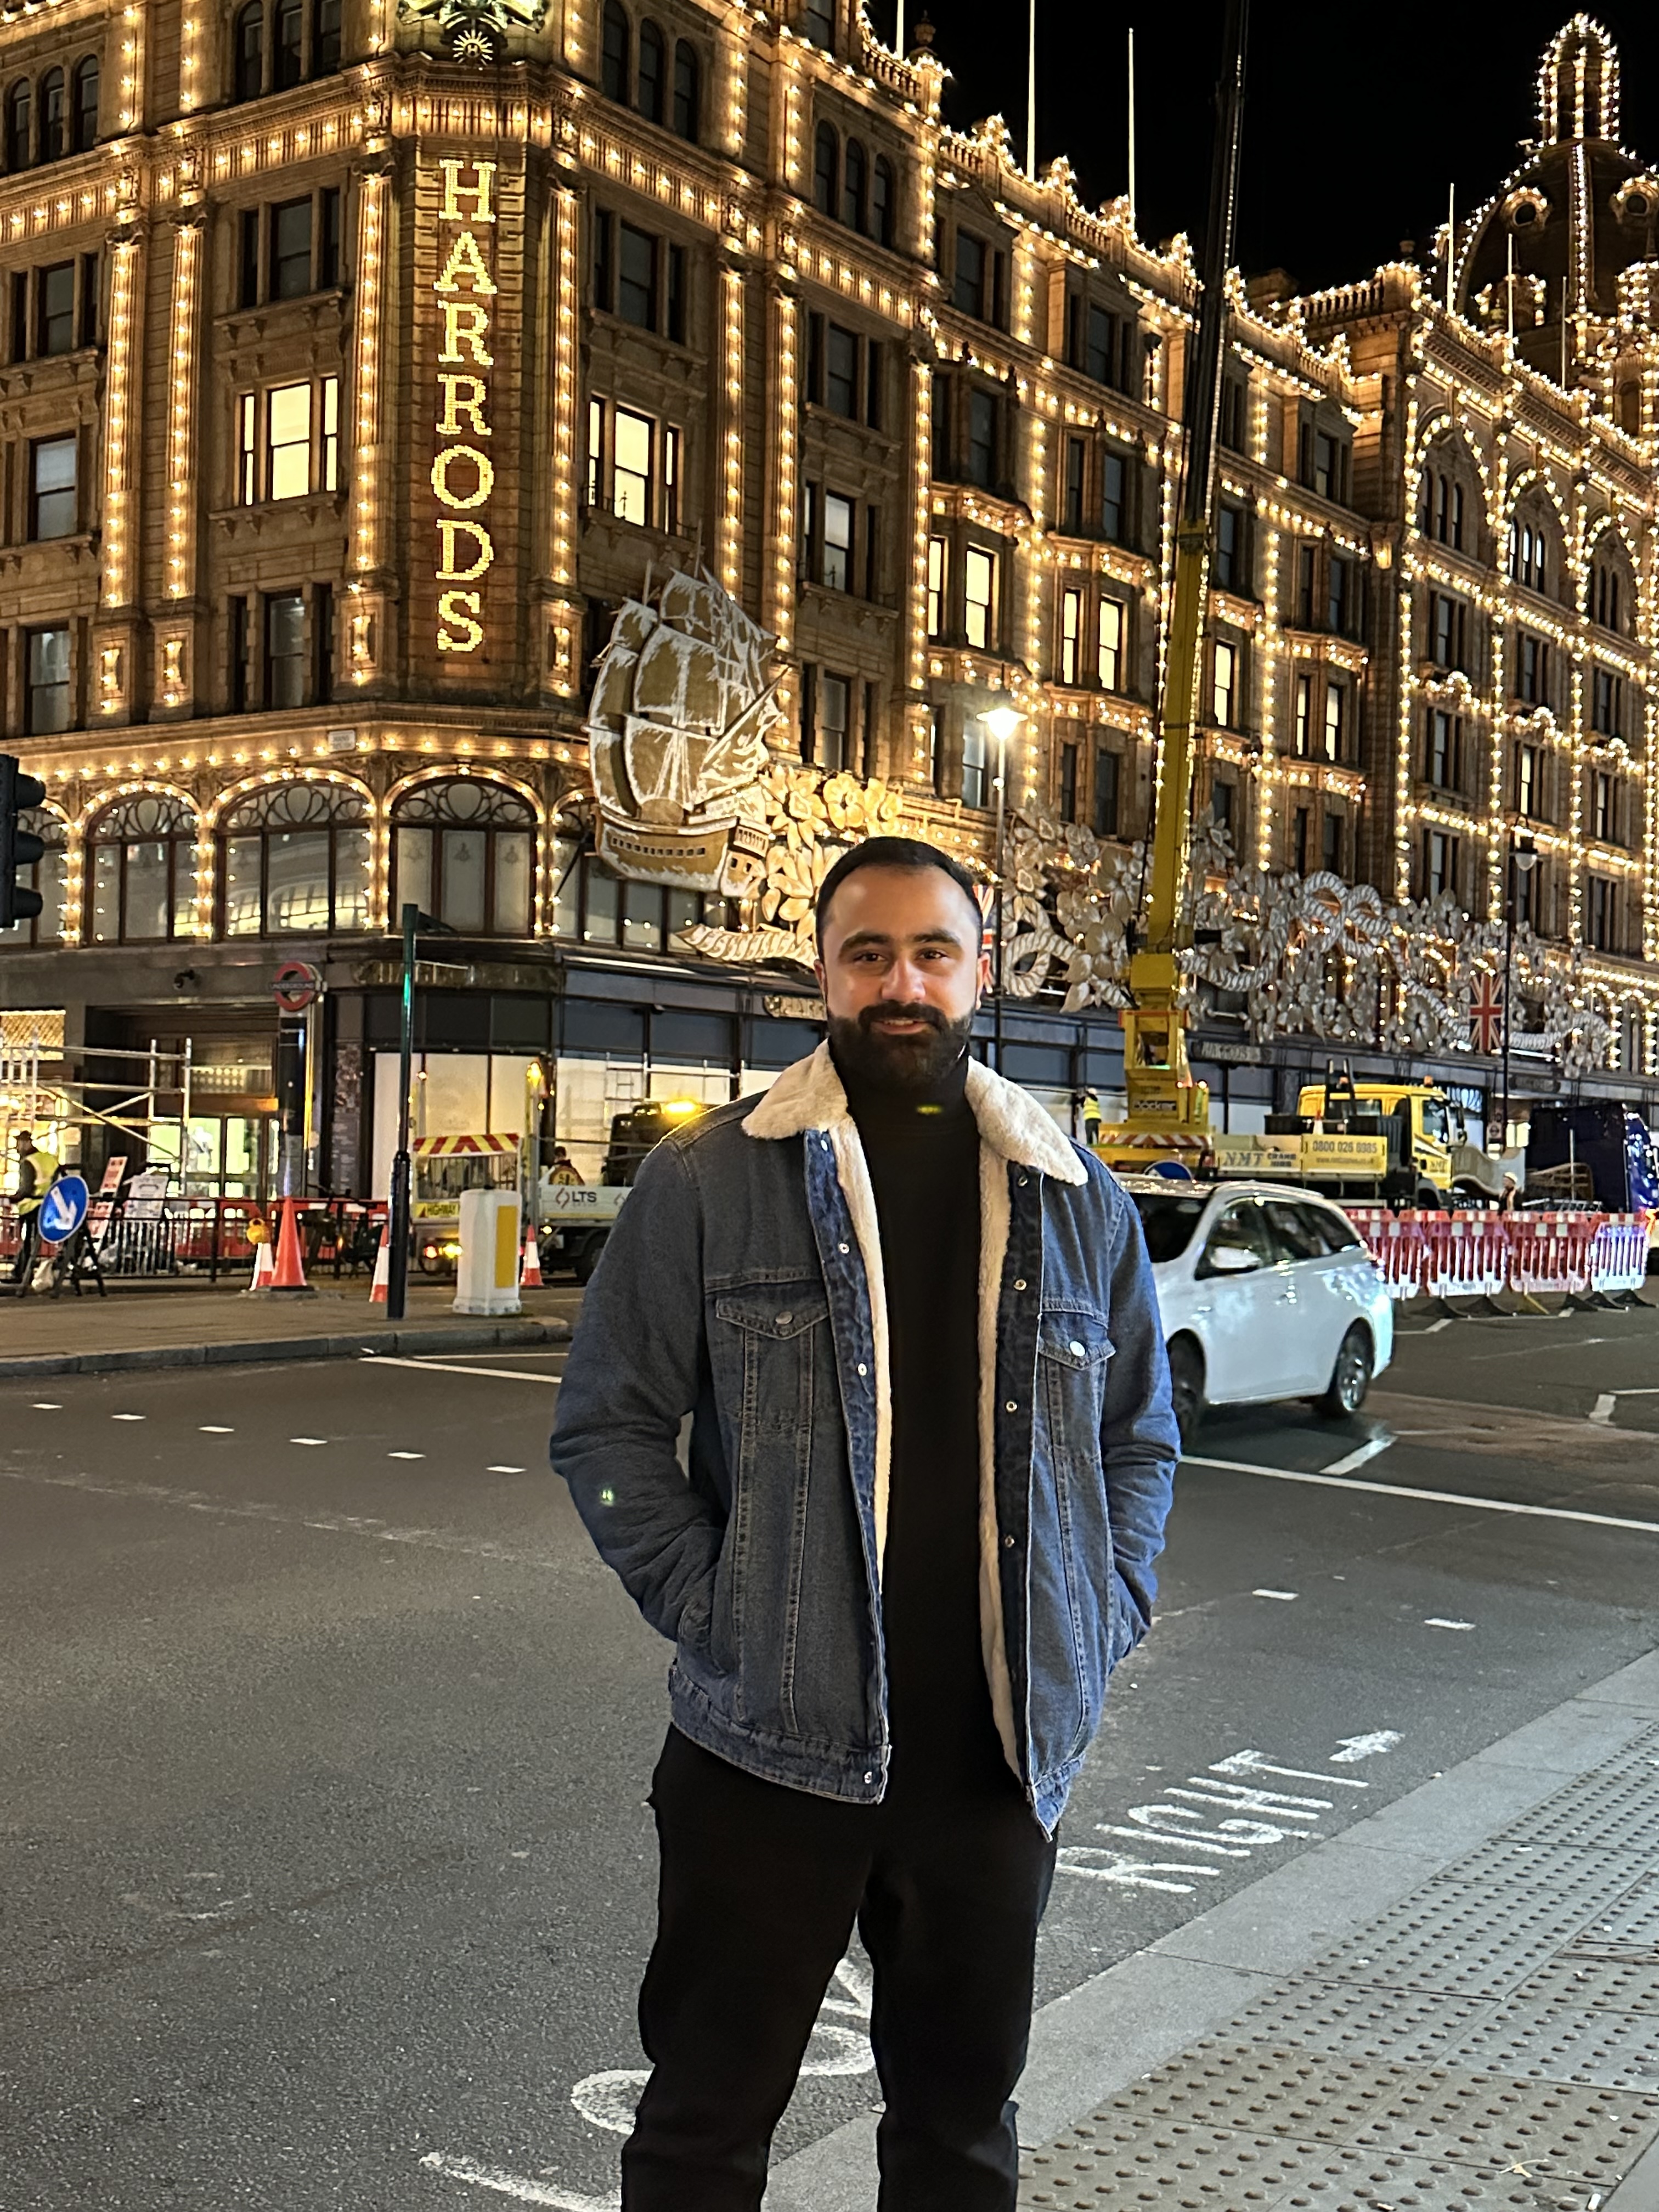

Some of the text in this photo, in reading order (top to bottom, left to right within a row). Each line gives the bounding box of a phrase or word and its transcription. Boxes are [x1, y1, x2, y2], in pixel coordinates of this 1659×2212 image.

[431, 159, 498, 652] HARRODS
[1312, 1140, 1335, 1152] 0800
[1223, 1152, 1263, 1167] NMT
[572, 1190, 597, 1203] LTS
[1056, 1748, 1369, 1894] RIGHT
